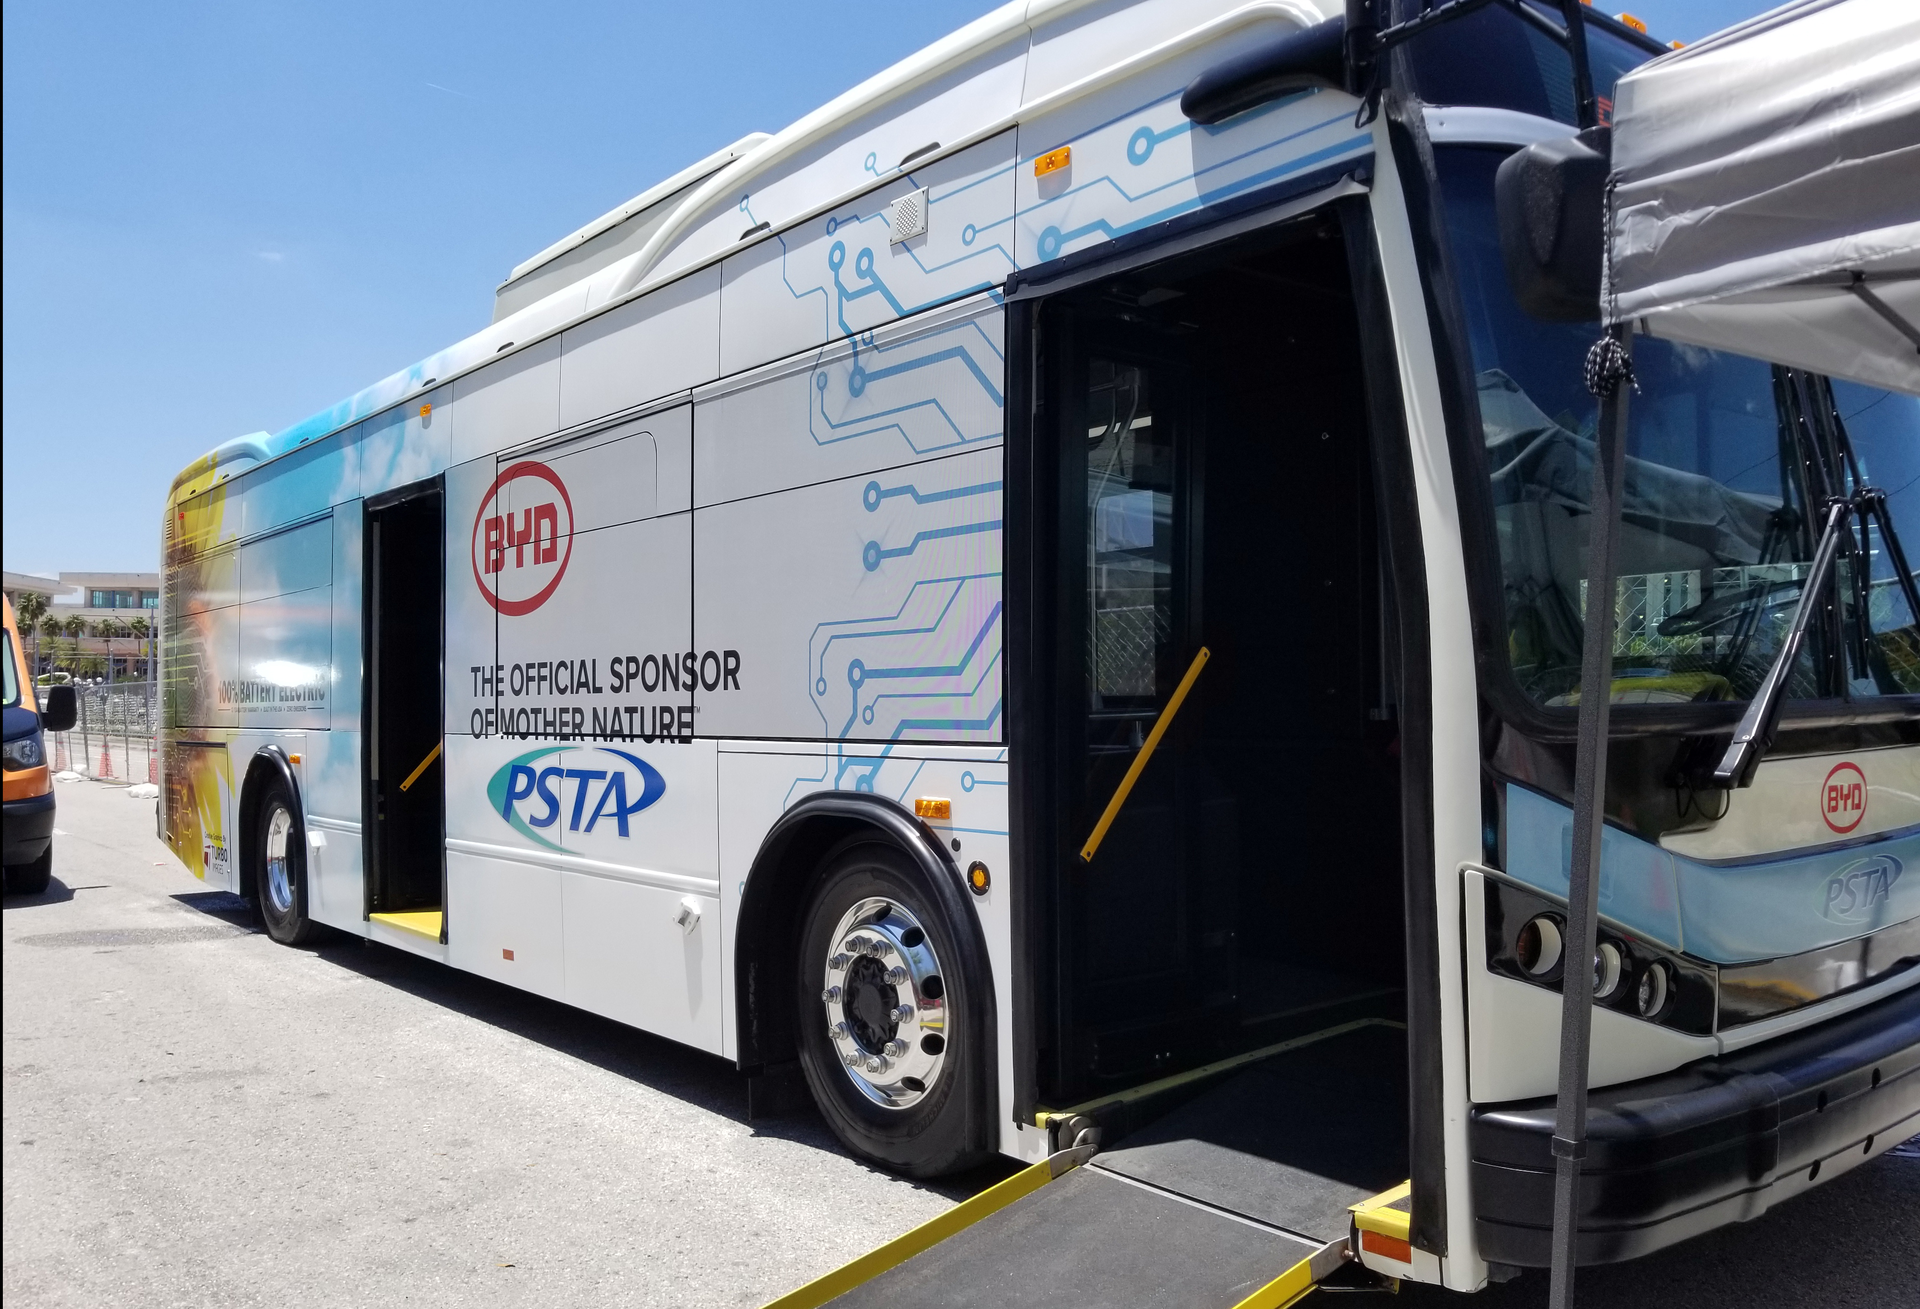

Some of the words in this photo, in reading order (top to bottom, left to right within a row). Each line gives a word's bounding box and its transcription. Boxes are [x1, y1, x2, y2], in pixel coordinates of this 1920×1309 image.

[485, 502, 557, 574] BYD
[470, 665, 504, 697] THE
[510, 661, 603, 696] OFFICIAL
[609, 650, 741, 693] SPONSOR
[470, 708, 494, 739] OF
[500, 707, 585, 741] MOTHER
[502, 764, 629, 838] PSTA
[1827, 783, 1862, 813] BYD
[211, 844, 228, 863] TURBO
[1823, 865, 1890, 919] PSTA
